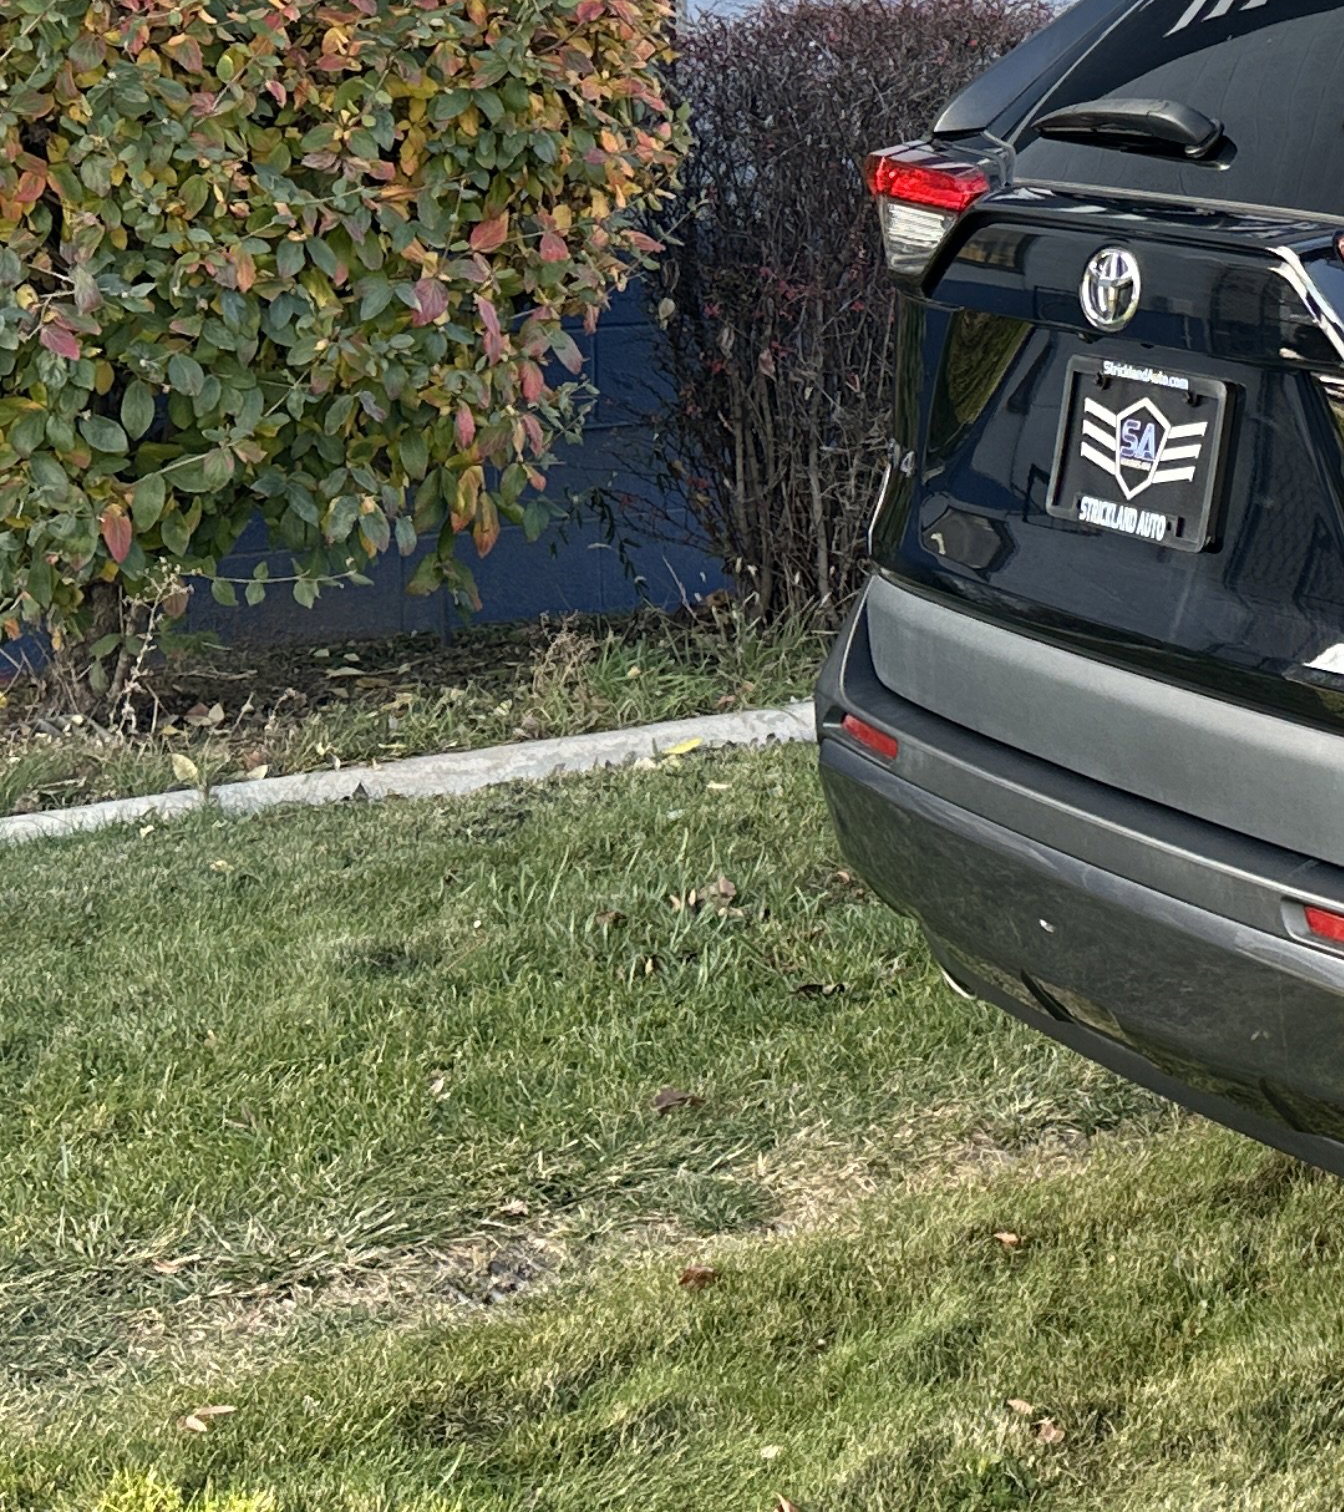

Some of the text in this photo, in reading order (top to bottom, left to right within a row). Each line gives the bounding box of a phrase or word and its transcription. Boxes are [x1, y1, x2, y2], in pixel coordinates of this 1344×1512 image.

[1103, 360, 1189, 390] StricklandAuto.com
[1120, 419, 1157, 461] SA
[1079, 496, 1166, 541] STRICKLAND AUTO
